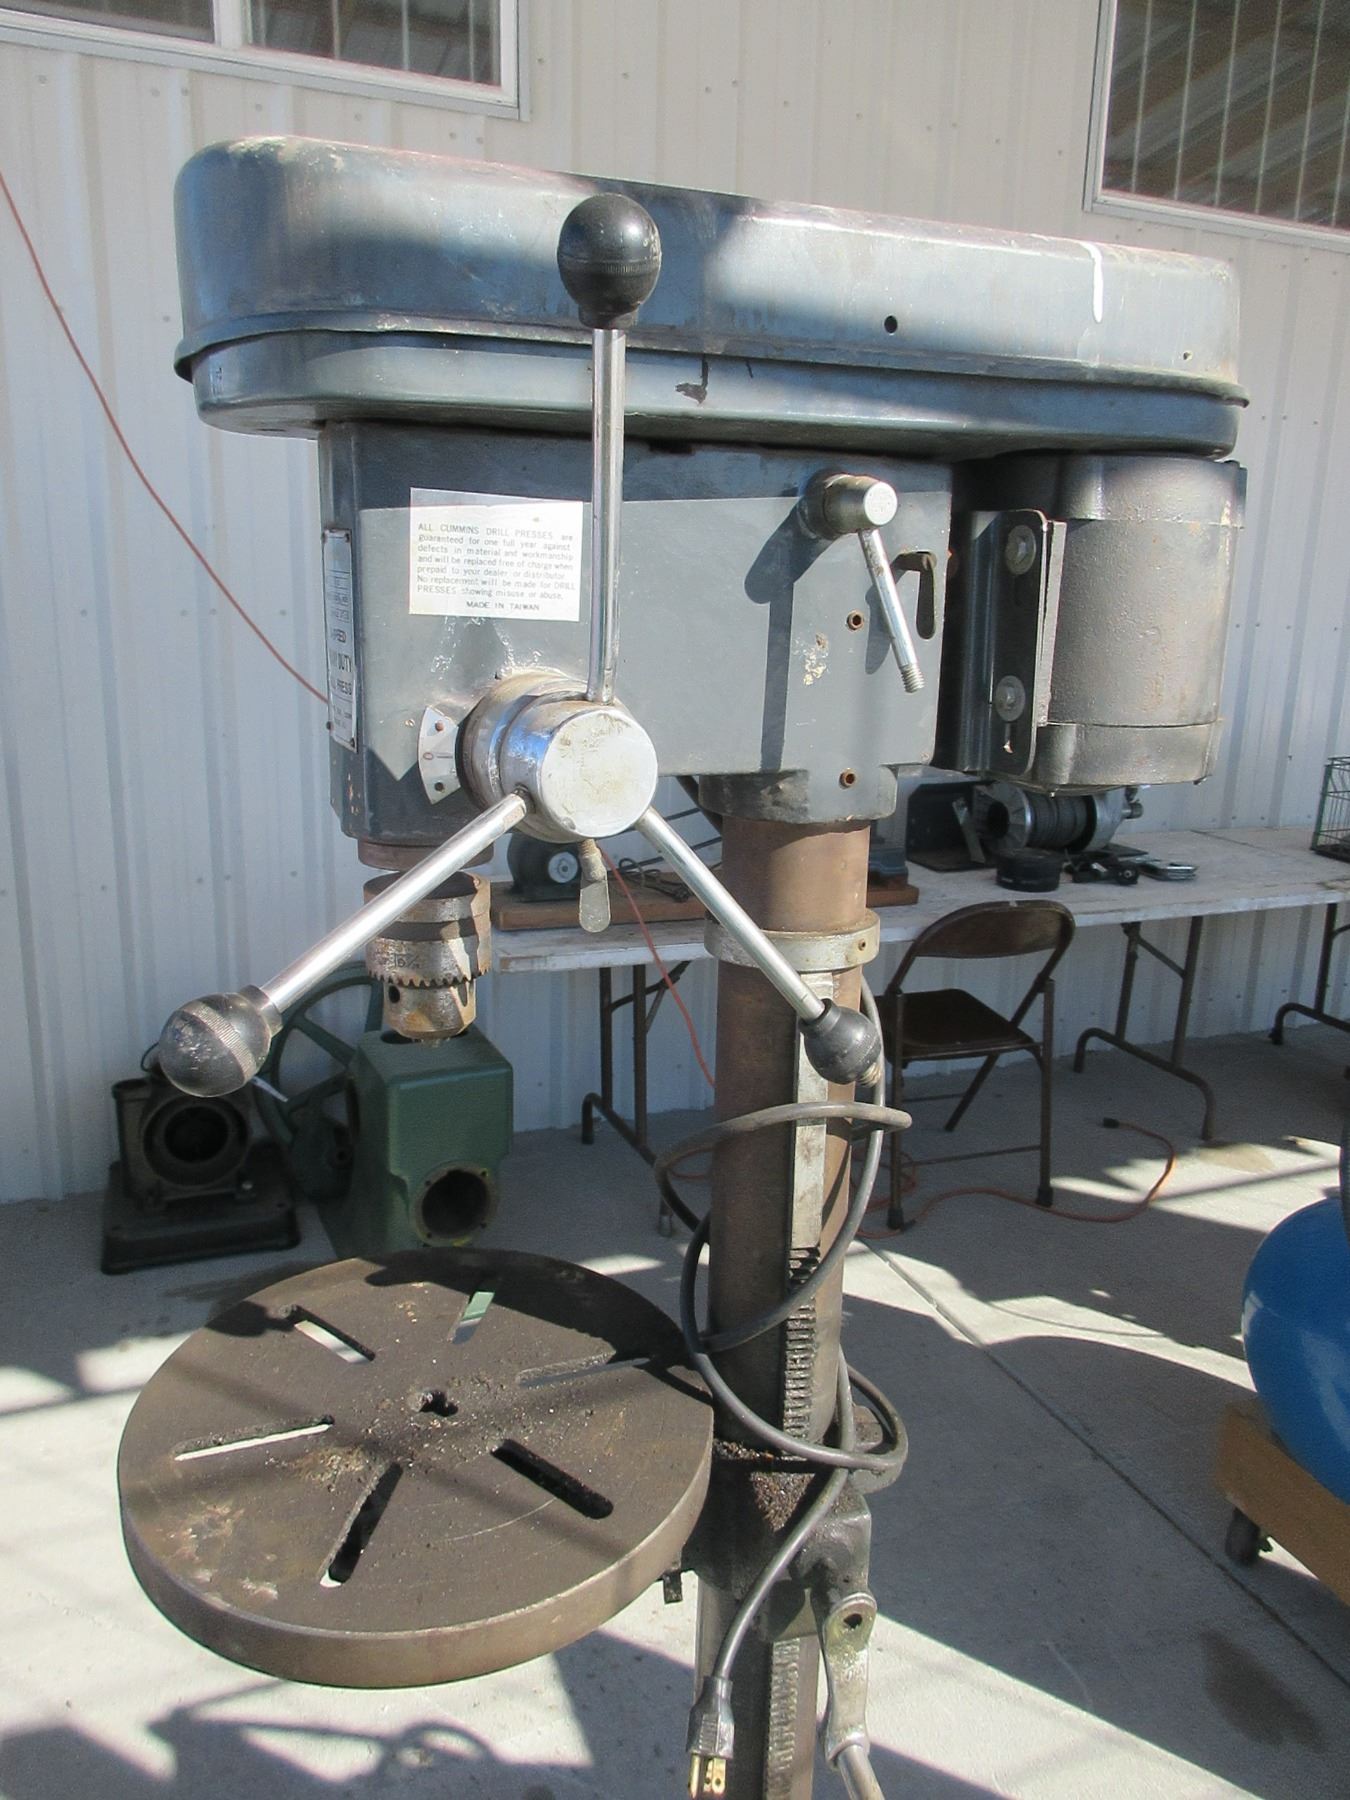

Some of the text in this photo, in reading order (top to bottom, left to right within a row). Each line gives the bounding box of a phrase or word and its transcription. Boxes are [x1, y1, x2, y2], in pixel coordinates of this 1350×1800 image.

[418, 523, 432, 531] ALL
[440, 524, 480, 534] CUMMINS
[486, 528, 509, 537] DRILL
[515, 529, 553, 540] PRESSES
[419, 534, 464, 544] guaranteed
[469, 537, 480, 545] for
[503, 539, 515, 547] full
[543, 543, 570, 551] against
[418, 544, 448, 553] defects
[467, 548, 501, 556] material
[522, 551, 574, 562] workmanship
[418, 555, 432, 563] and
[435, 556, 449, 564] will
[451, 556, 461, 564] be
[464, 557, 497, 567] replaced
[499, 559, 515, 568] free
[516, 560, 525, 568] of
[527, 561, 553, 571] charge
[417, 566, 447, 575] prepaid
[451, 567, 460, 575] to
[463, 569, 481, 577] your
[484, 568, 508, 577] dealer
[417, 575, 429, 583] No
[431, 576, 480, 585] replacement
[481, 578, 498, 586] will
[514, 581, 537, 589] made
[540, 581, 552, 589] for
[554, 582, 576, 590] DRILL
[417, 585, 457, 595] PRESSES
[461, 587, 493, 598] showing
[495, 590, 525, 598] misuse
[466, 601, 491, 609] MADE
[510, 603, 540, 611] TAIWAN
[337, 652, 352, 673] DUTY
